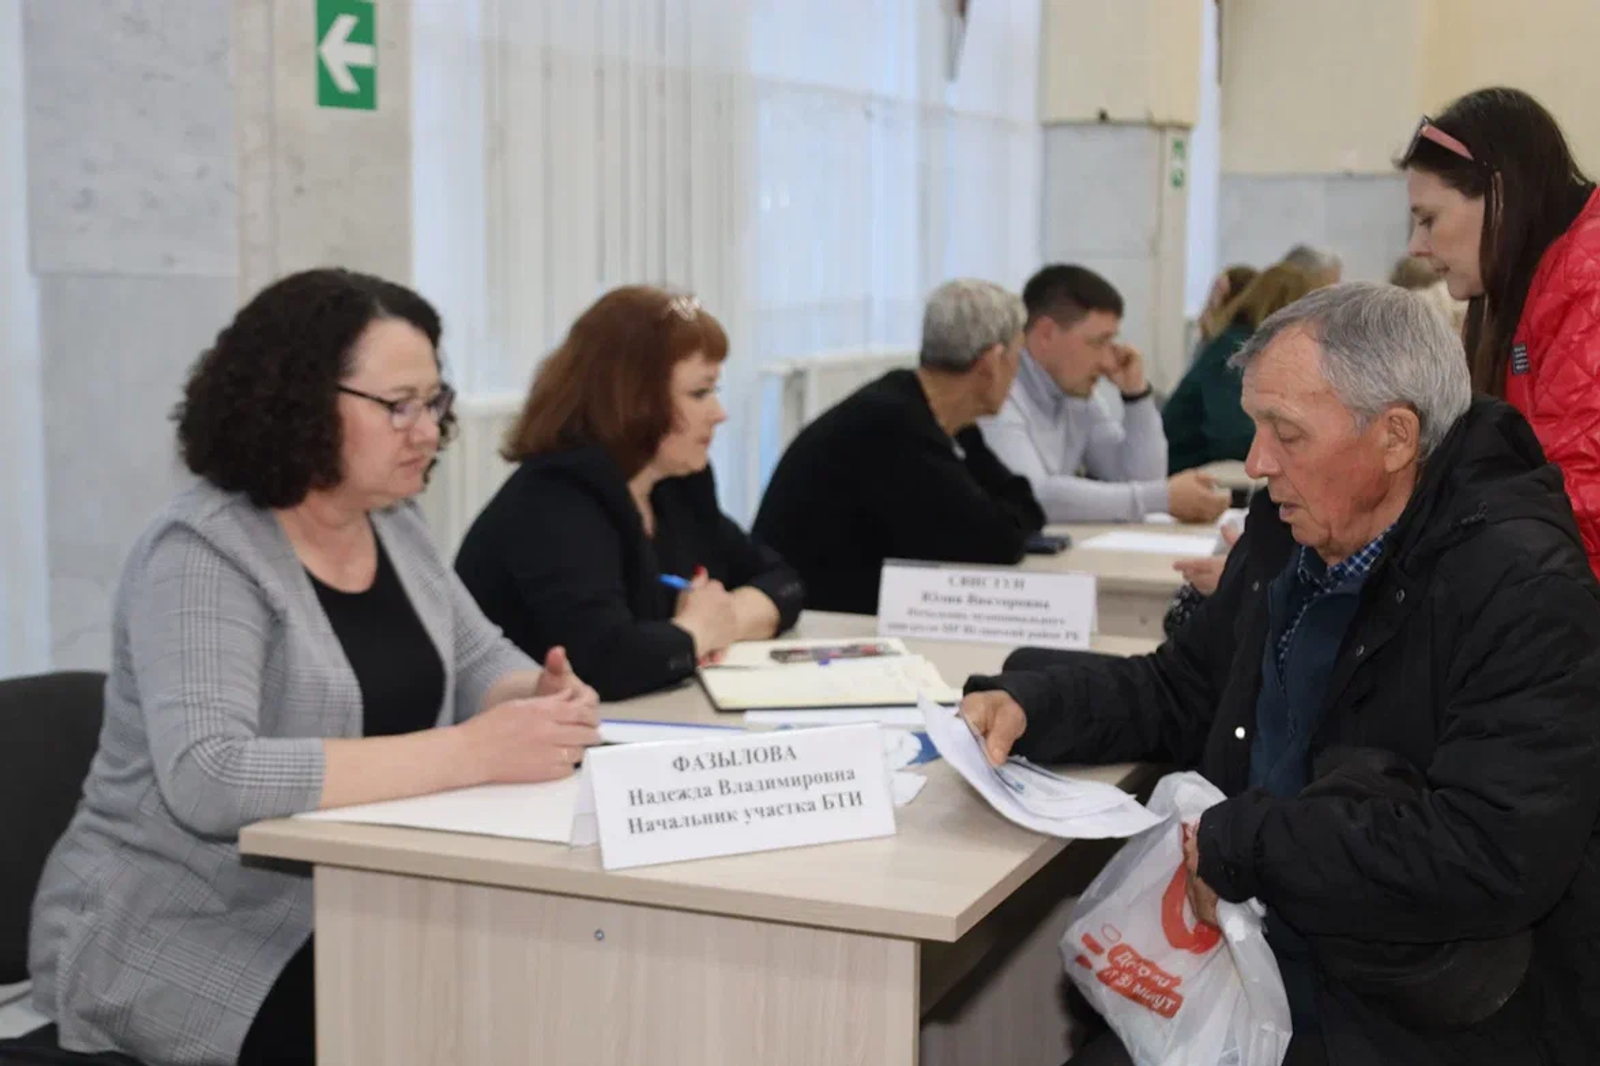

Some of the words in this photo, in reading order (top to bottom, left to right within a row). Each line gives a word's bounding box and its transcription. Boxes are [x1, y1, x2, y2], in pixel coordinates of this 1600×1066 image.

[672, 745, 798, 772] ФАЗЫЛОВА
[628, 785, 712, 808] Надежда
[718, 768, 856, 796] Владимировна
[628, 808, 738, 834] Начальник
[744, 800, 817, 824] участка
[822, 790, 864, 811] БТИ
